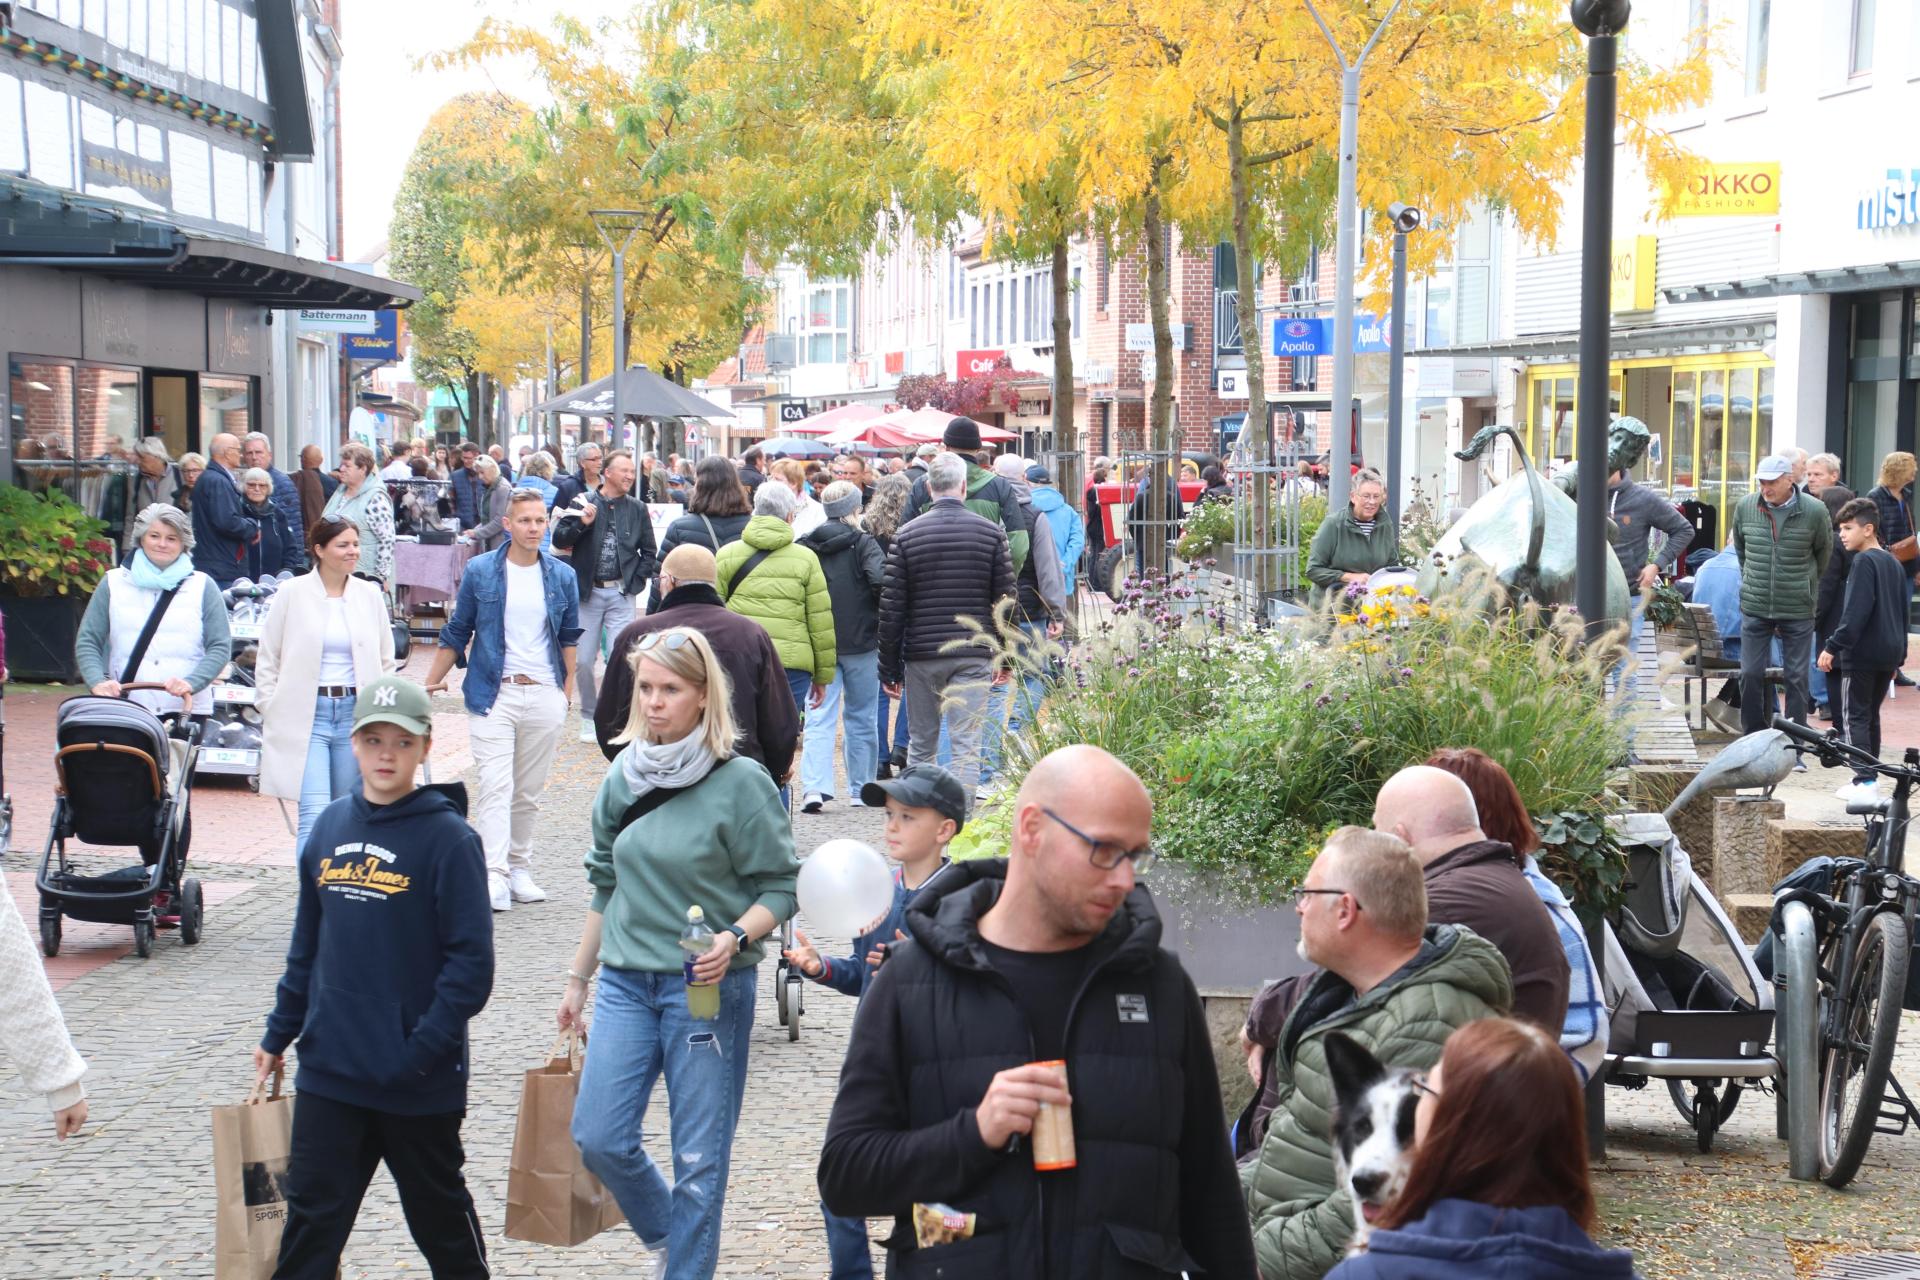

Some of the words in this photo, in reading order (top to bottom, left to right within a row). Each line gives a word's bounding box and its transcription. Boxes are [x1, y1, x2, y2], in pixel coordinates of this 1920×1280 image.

[1684, 199, 1756, 208] FASHION
[300, 308, 367, 320] Battermann
[1357, 323, 1381, 348] Apollo
[1280, 341, 1315, 354] Apollo
[970, 359, 994, 373] Café
[1223, 380, 1234, 389] VP
